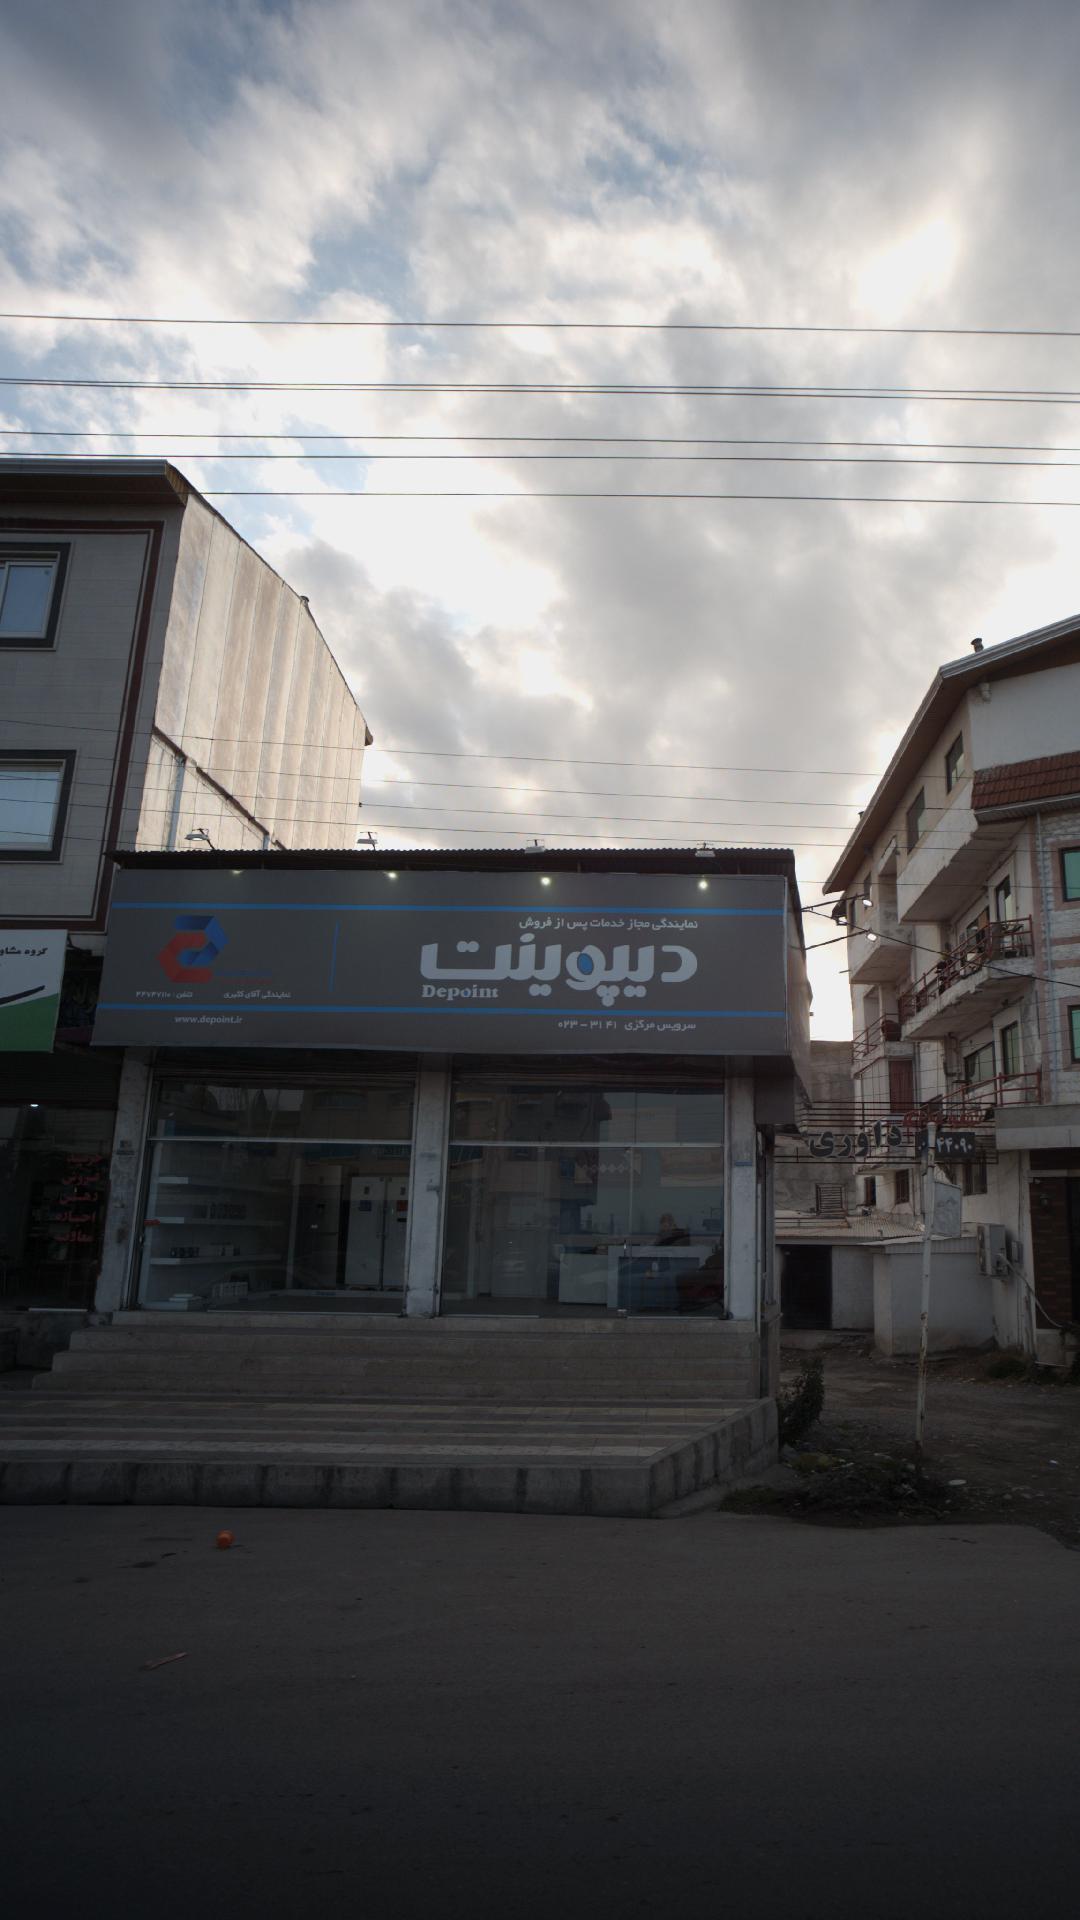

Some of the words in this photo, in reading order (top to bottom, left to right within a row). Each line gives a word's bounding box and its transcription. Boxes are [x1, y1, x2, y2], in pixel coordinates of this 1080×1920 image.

[518, 916, 552, 929] فروش
[553, 917, 565, 929] از
[566, 919, 588, 931] پس
[590, 917, 625, 929] خدمات
[627, 919, 650, 931] مجاز
[651, 918, 699, 931] نمایندگی
[420, 932, 698, 1008] دیپوینت
[421, 984, 499, 1001] Depoint
[174, 1015, 244, 1025] www.depoint.ir
[624, 1019, 655, 1031] مرکزی
[656, 1021, 697, 1032] سرویس
[809, 1119, 903, 1158] داوری
